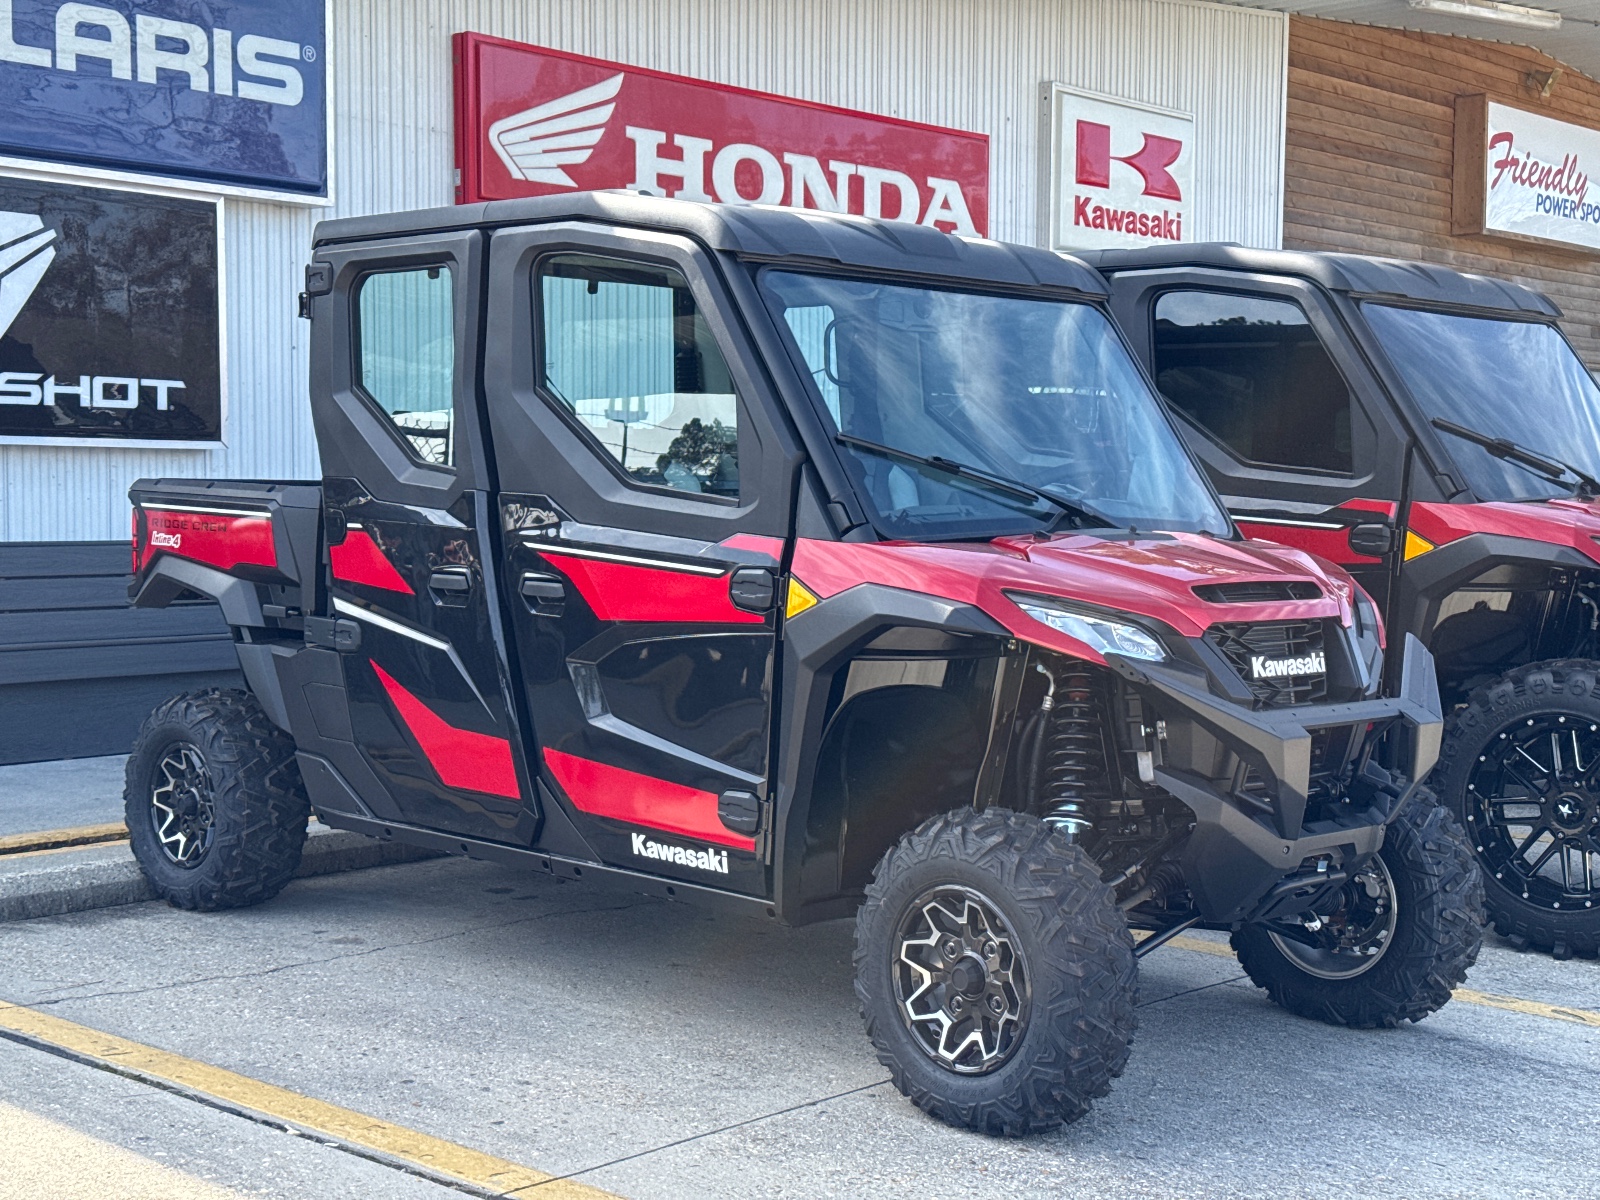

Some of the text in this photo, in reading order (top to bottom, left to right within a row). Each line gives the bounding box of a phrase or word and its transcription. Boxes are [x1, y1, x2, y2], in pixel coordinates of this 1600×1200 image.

[625, 125, 984, 239] HONDA
[1488, 131, 1589, 212] Friendly
[1073, 194, 1182, 242] Kawasaki
[1535, 193, 1577, 220] POWER
[151, 517, 227, 533] RIDGE CREW
[1251, 651, 1327, 678] Kawasaki
[631, 832, 729, 874] Kawasaki
